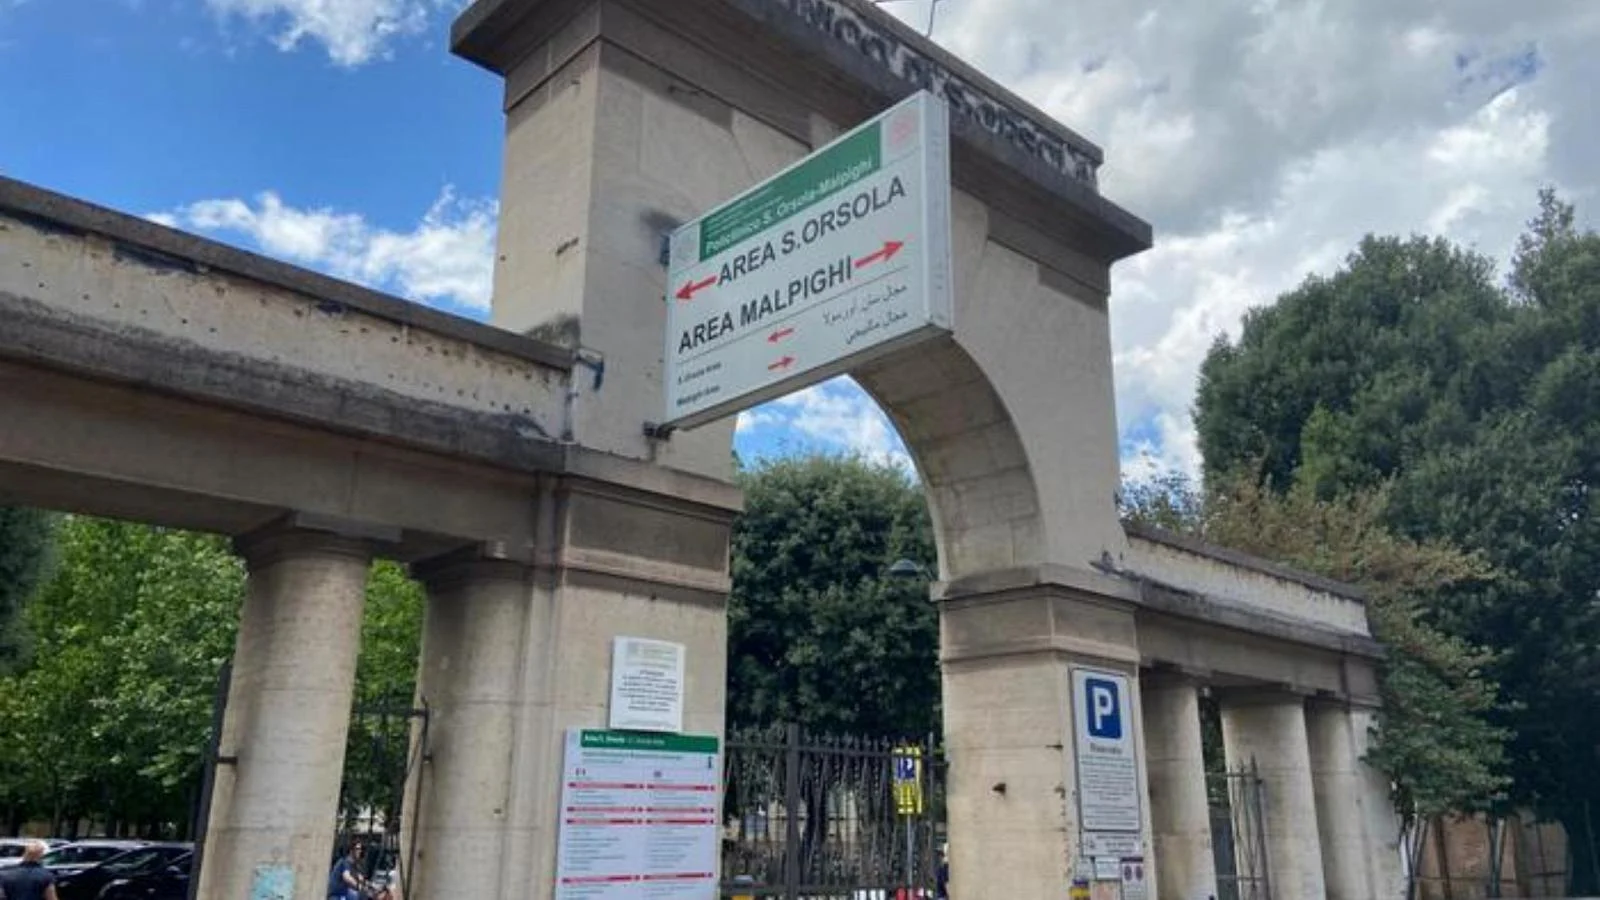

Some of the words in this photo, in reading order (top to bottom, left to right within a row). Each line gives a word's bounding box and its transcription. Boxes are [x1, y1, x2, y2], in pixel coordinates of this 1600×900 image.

[717, 241, 776, 287] AREA
[781, 175, 906, 255] S.ORSOLA
[677, 311, 735, 354] AREA
[739, 255, 852, 327] MALPIGHI
[1091, 687, 1114, 731] P
